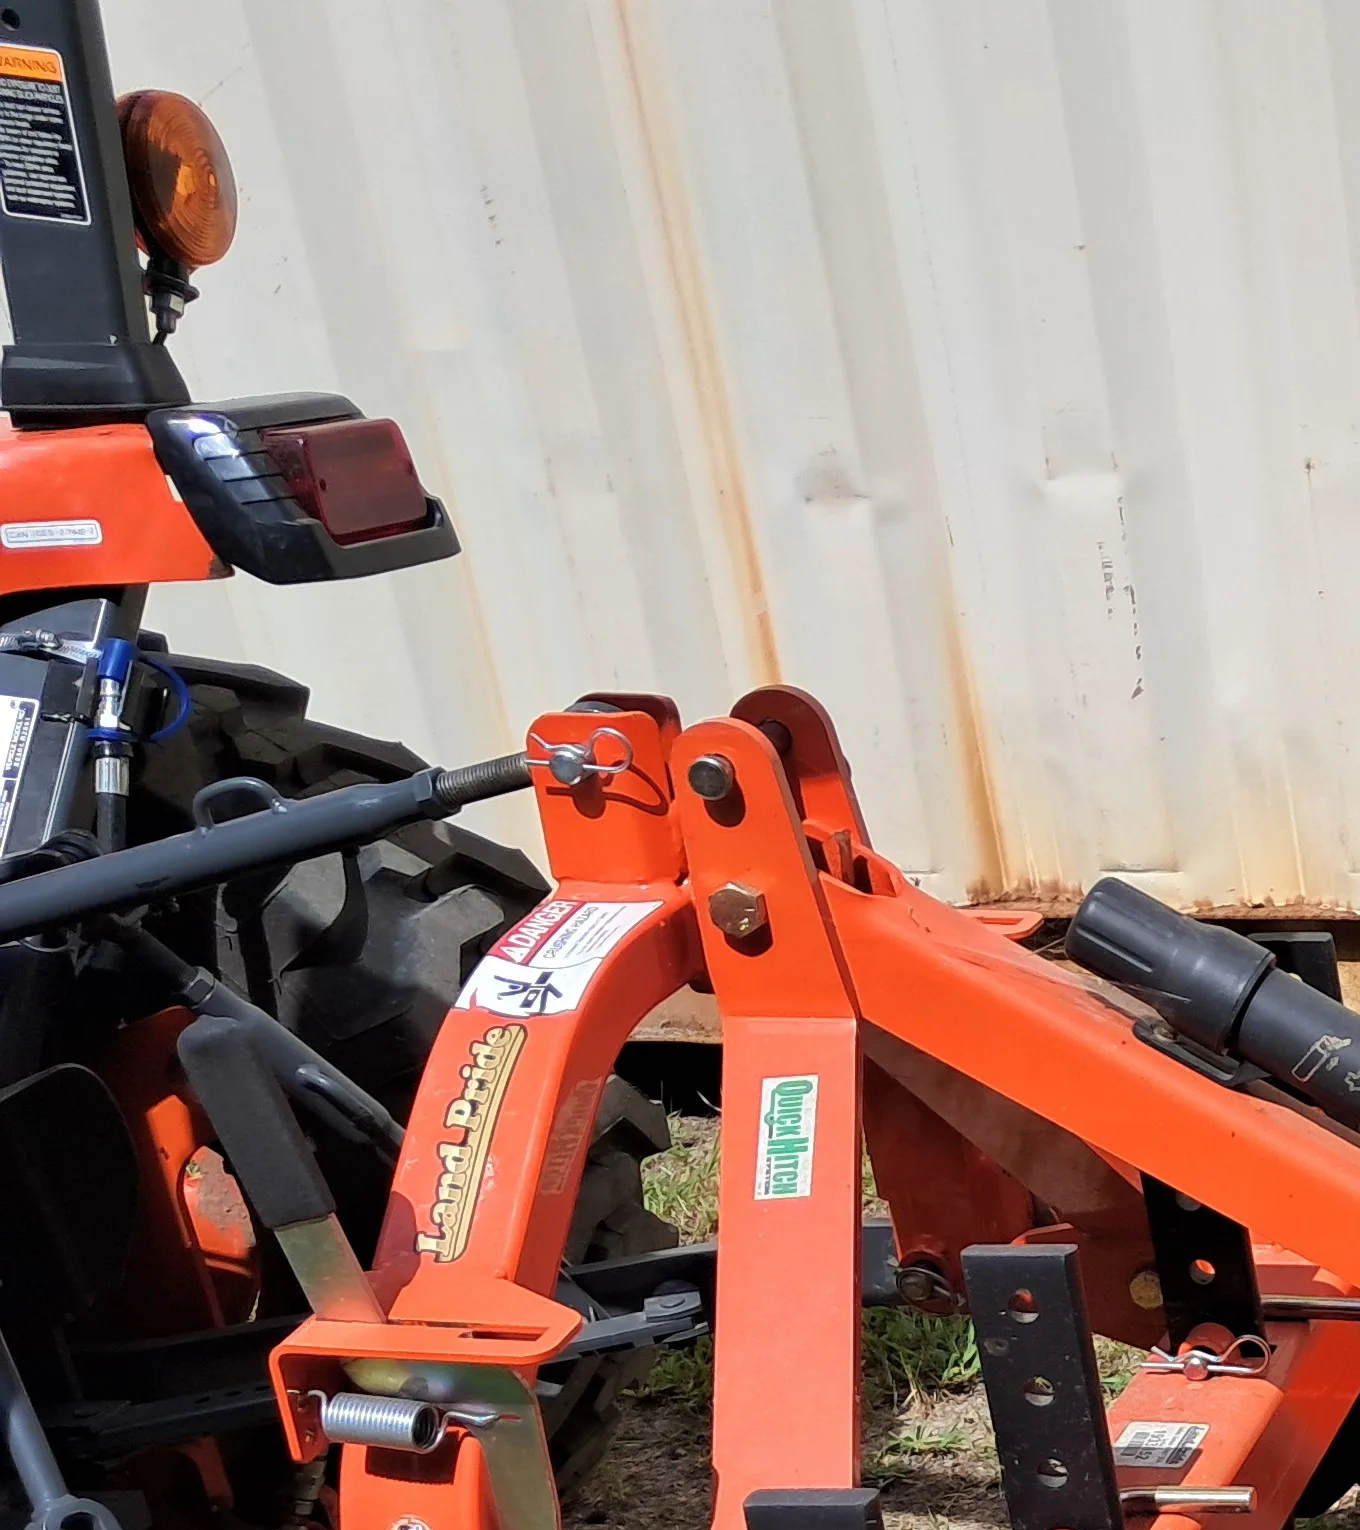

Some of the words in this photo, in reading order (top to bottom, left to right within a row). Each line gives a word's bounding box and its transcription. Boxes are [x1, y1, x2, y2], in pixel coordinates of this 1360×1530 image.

[0, 56, 57, 74] ARNING
[507, 901, 578, 948] DANGER
[444, 1026, 512, 1132] Pride
[416, 1142, 473, 1258] Land
